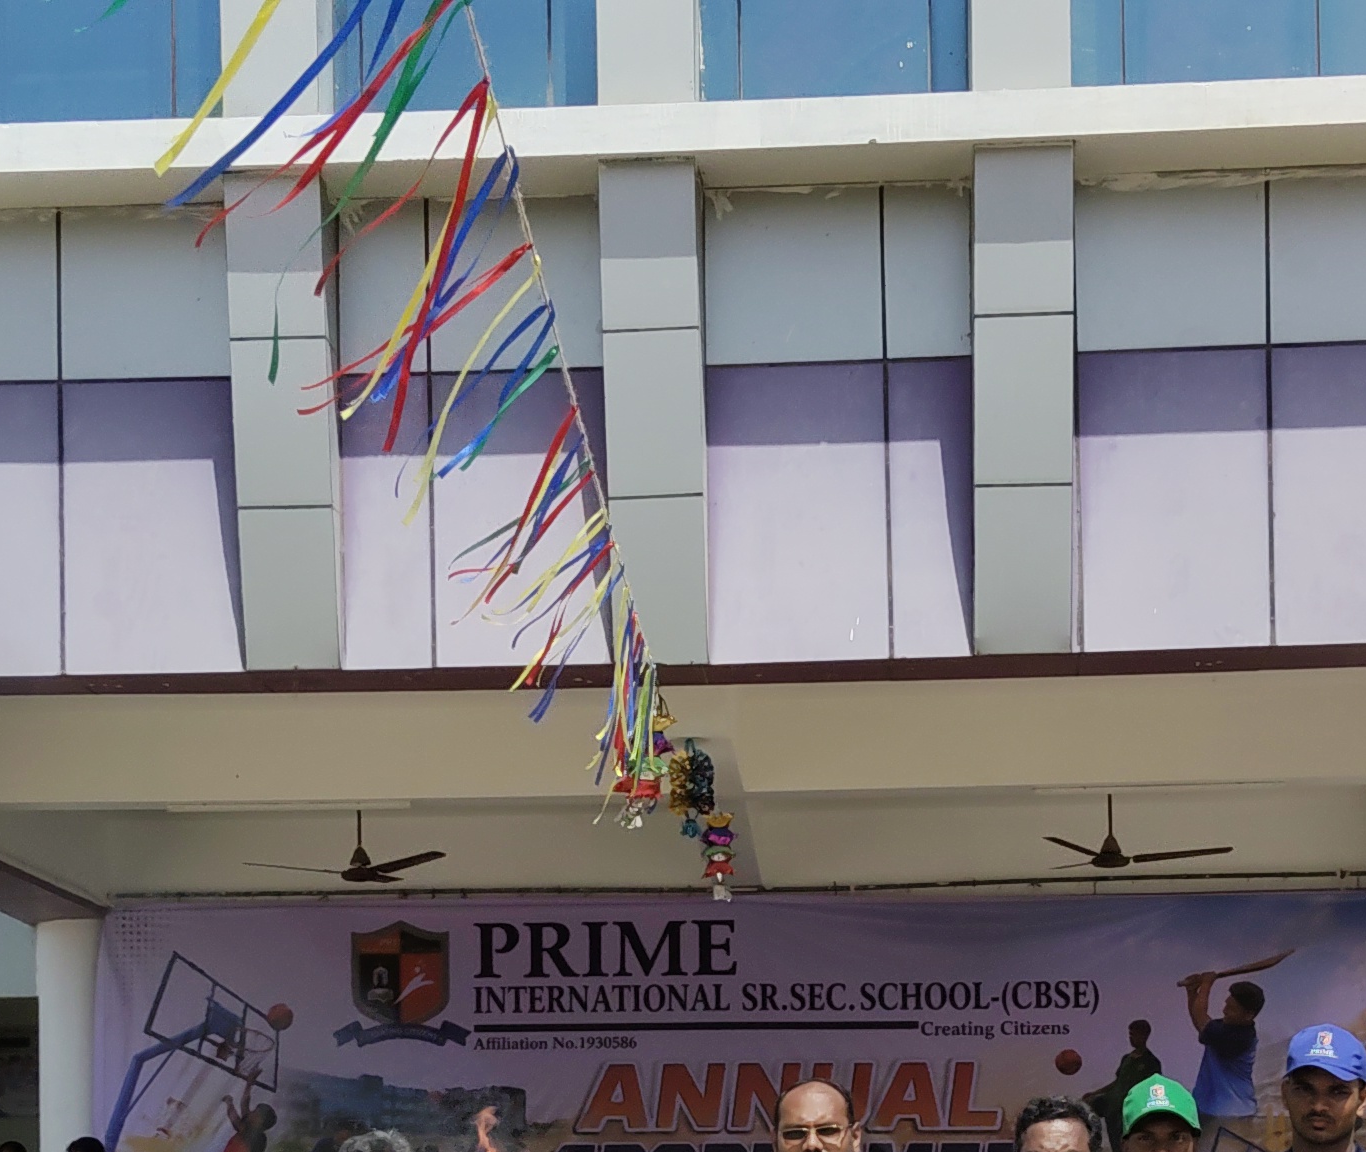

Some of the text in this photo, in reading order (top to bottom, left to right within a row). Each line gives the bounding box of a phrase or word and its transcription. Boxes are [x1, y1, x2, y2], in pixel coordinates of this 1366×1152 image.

[473, 920, 737, 978] PRIME
[473, 984, 731, 1014] INTERNATIONAL
[920, 1020, 1070, 1039] Creating Citizens
[473, 1035, 548, 1051] Affiliation
